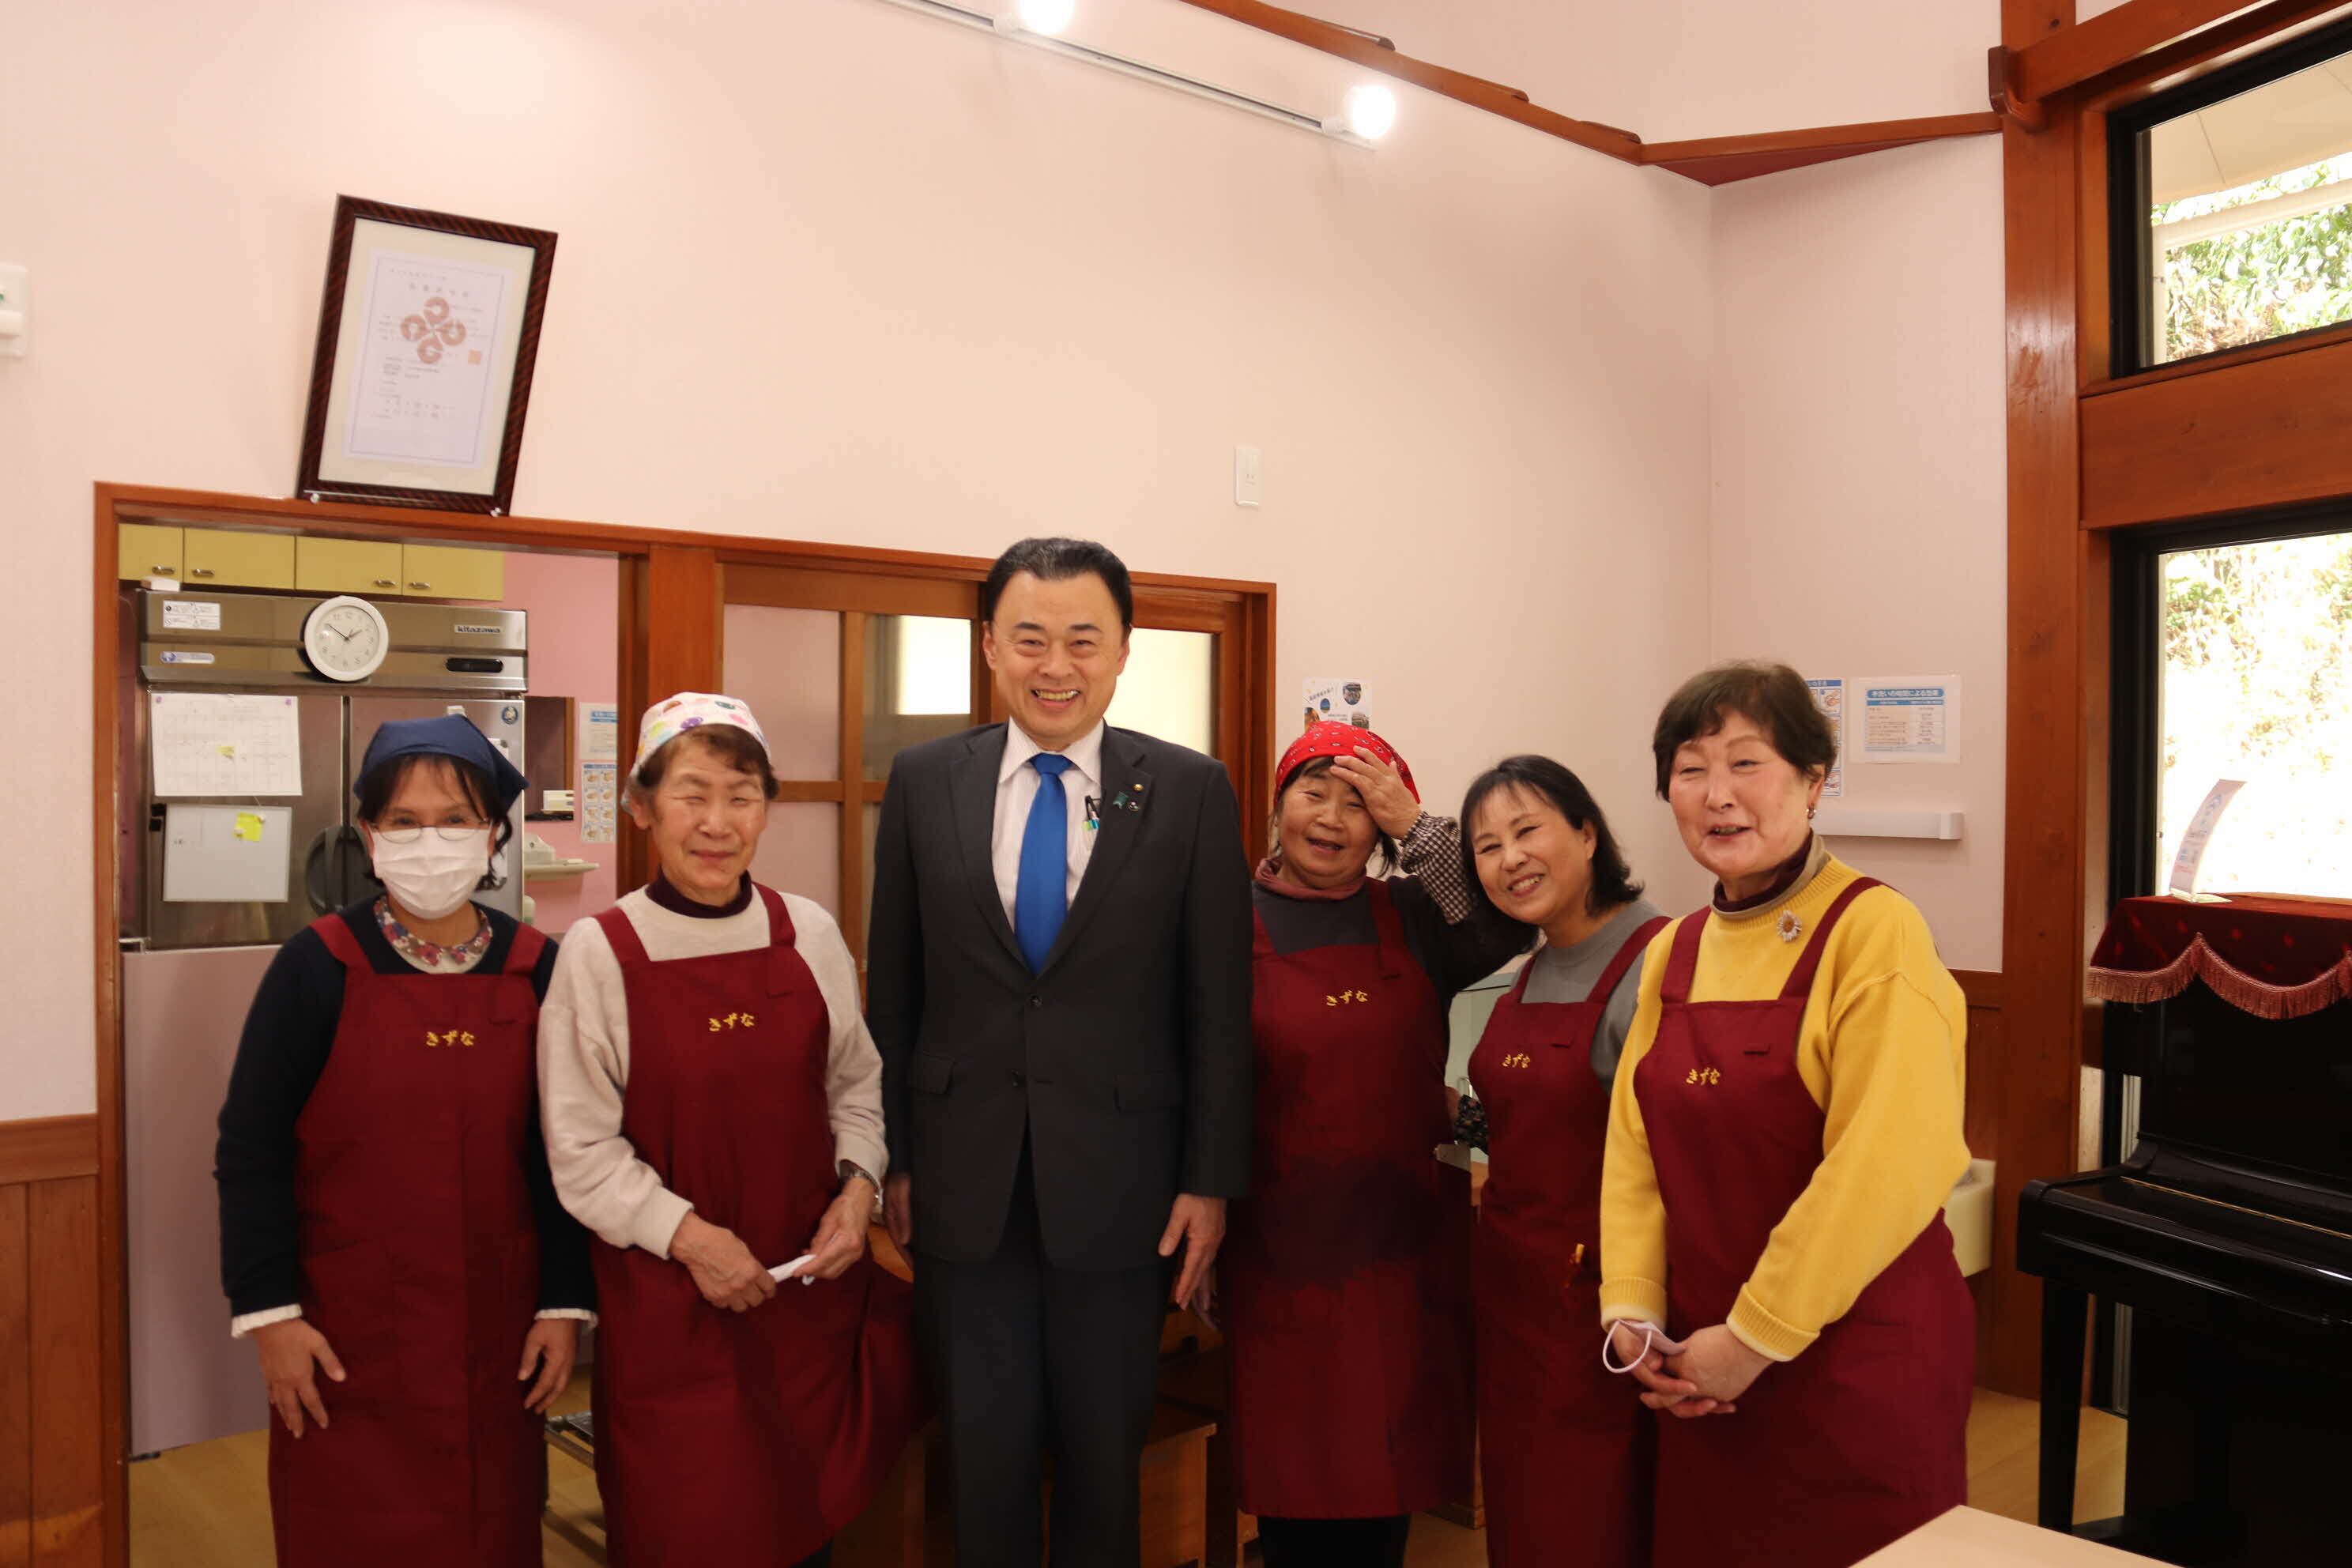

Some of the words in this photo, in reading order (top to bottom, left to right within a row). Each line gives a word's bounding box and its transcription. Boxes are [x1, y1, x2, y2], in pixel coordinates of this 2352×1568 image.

[1326, 989, 1368, 1006] きずな
[708, 1012, 755, 1031] きずな
[426, 1030, 475, 1046] きずな
[1501, 1053, 1531, 1069] きずな
[1685, 1067, 1721, 1085] きずな
